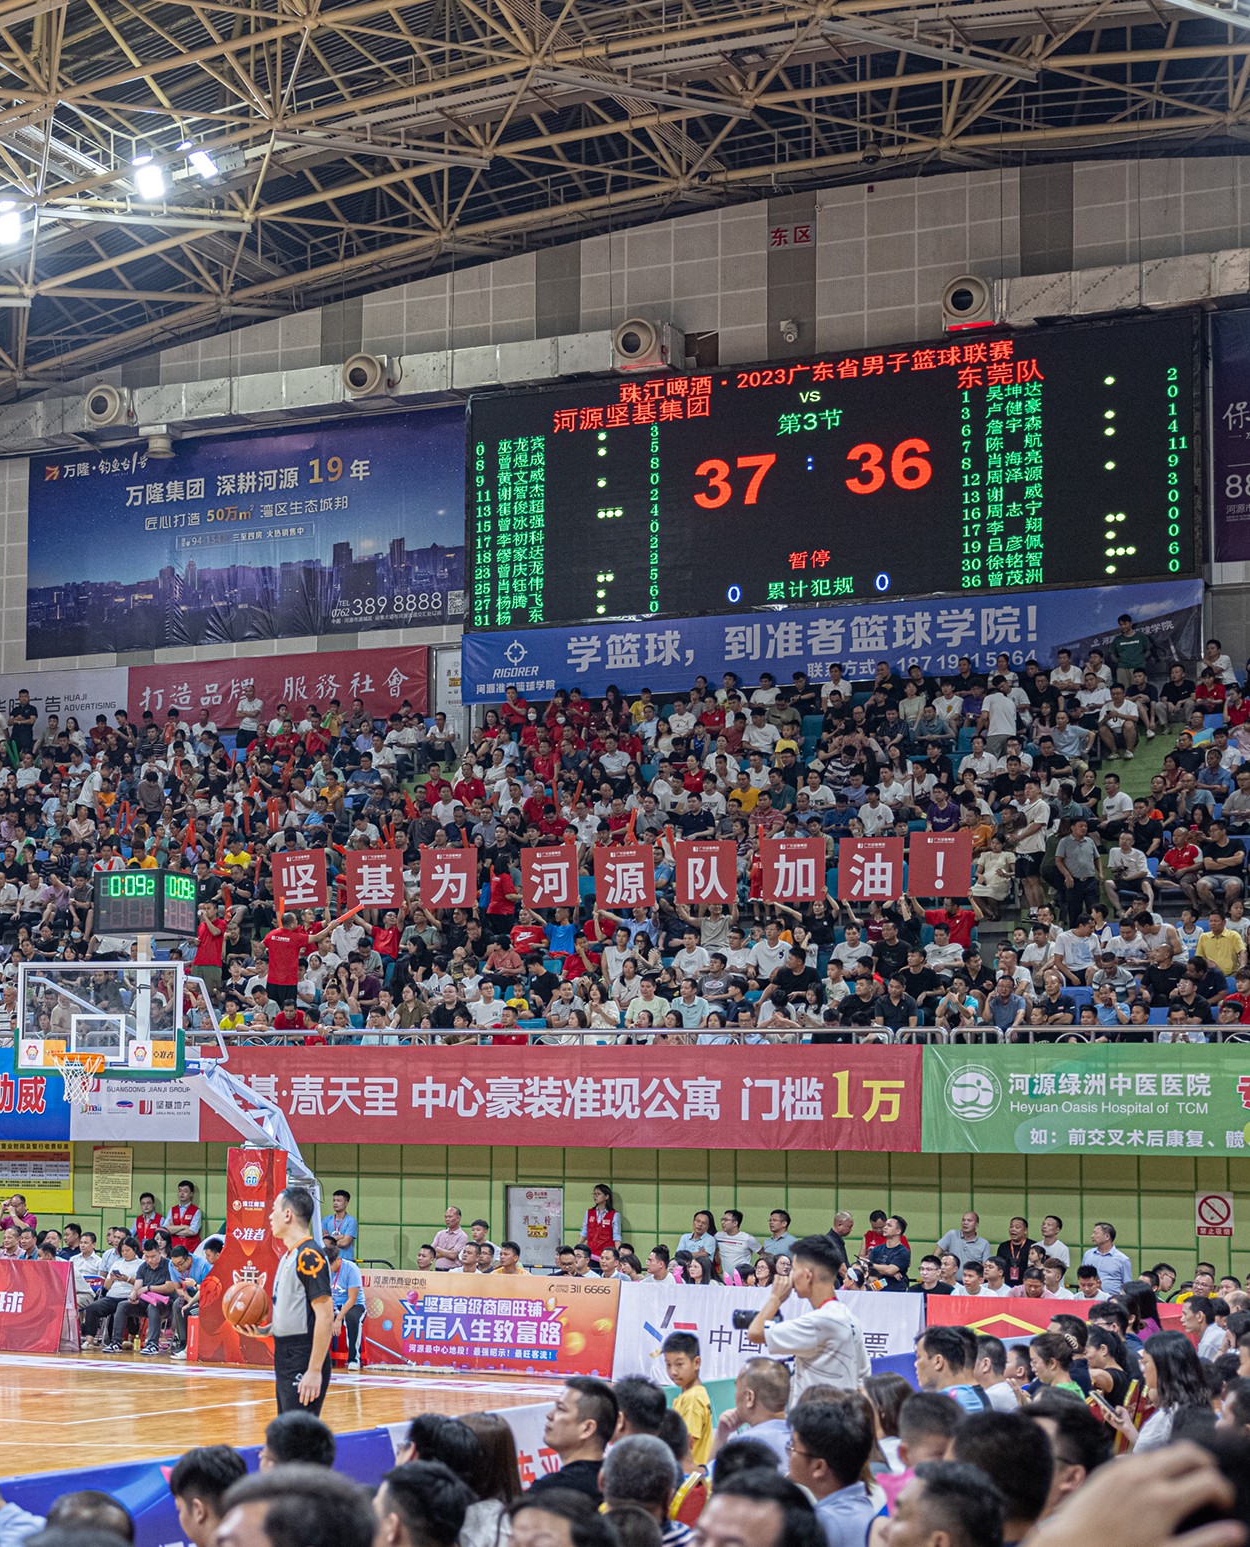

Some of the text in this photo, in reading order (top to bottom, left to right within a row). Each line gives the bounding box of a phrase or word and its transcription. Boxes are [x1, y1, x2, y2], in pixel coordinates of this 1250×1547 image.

[770, 225, 811, 247] 东区
[553, 358, 1045, 434] 河源坚基集团 东莞队
[961, 367, 1179, 403] 1 吴坤达 2
[961, 385, 1179, 420] 3 卢健豪 0
[776, 409, 843, 437] 第3节
[961, 402, 1179, 437] 6 詹宇森 1
[476, 443, 485, 456] 0
[650, 425, 659, 437] 3
[961, 440, 971, 454] 7
[1167, 419, 1179, 433] 4
[476, 458, 485, 471] 8
[650, 440, 659, 453] 5
[961, 435, 1188, 470] 8 肖海亮 11
[476, 456, 659, 487] 9 黄文威 8
[693, 437, 934, 510] 37 36
[961, 454, 1179, 487] 12 周泽源 9
[125, 477, 205, 507] 万隆集团
[216, 466, 299, 497] 深耕河源
[476, 473, 659, 503] 11 谢智杰 0
[961, 490, 981, 504] 13
[1167, 472, 1179, 485] 3
[145, 496, 349, 531] 匠心打造 湾区生态城邦
[476, 505, 491, 518] 13
[650, 488, 659, 501] 2
[476, 520, 491, 533] 15
[650, 503, 659, 517] 4
[961, 489, 1179, 521] 16 周志宁 0
[476, 520, 659, 549] 17 李初科 0
[961, 524, 981, 538] 17
[1167, 506, 1179, 520] 0
[476, 551, 491, 564] 18
[650, 536, 659, 549] 2
[961, 523, 1179, 554] 19 吕彦佩 0
[475, 552, 659, 579] 23 曾庆龙 2
[788, 549, 831, 570] 暂停
[961, 541, 1179, 571] 30 徐铭智 6
[475, 582, 491, 595] 25
[650, 568, 659, 581] 5
[727, 573, 889, 603] 0 累计犯规 0
[961, 559, 1179, 588] 36 曾茂洲 0
[352, 596, 388, 616] 389
[393, 591, 442, 613] 8888
[475, 597, 491, 611] 27
[650, 584, 659, 597] 6
[475, 613, 491, 626] 31
[650, 600, 659, 613] 0
[493, 666, 540, 680] RIGORER
[64, 693, 88, 701] HUAJI
[64, 701, 117, 712] ADVERTISING
[282, 864, 318, 905] 坚
[355, 863, 395, 905] 基
[430, 863, 467, 904] 为
[530, 862, 569, 904] 河
[604, 862, 647, 904] 源
[687, 856, 729, 900] 队
[773, 853, 815, 898] 加
[849, 852, 893, 897] 油
[411, 1076, 721, 1121] 中心豪装准现公寓
[1008, 1073, 1212, 1097] 河源绿洲中医医院
[156, 1100, 191, 1110] 坚基地产
[1010, 1101, 1208, 1116] Heyuan Oasis Hospital of TCM
[242, 1228, 265, 1241] 准者
[1199, 1227, 1233, 1236] 禁止吸烟
[373, 1276, 427, 1287] 河源市商业中心
[570, 1285, 611, 1295] 311 6666
[423, 1296, 543, 1317] 坚基省级商圈旺铺
[403, 1314, 562, 1346] 开启人生致富路
